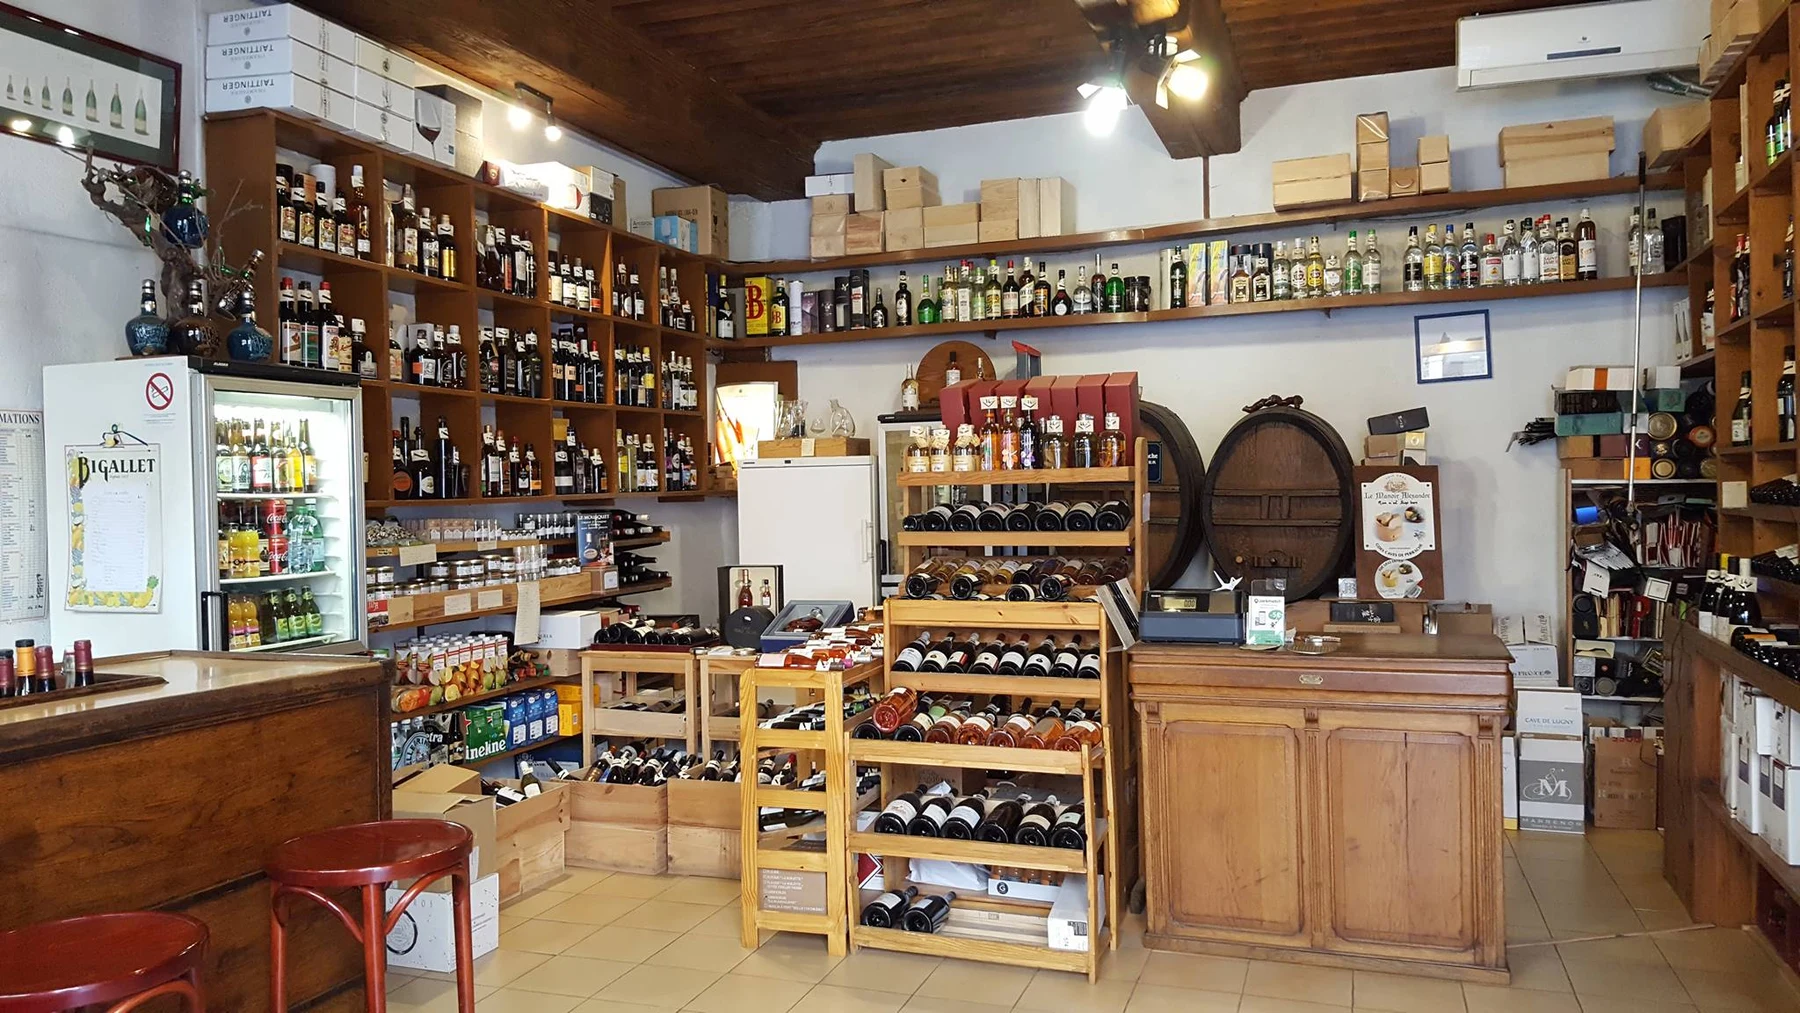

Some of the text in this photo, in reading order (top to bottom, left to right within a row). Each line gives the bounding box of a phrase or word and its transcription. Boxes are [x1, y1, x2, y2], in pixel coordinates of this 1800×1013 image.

[223, 9, 272, 23] TAITTINGER
[222, 44, 274, 57] TAITTINGER
[222, 78, 274, 91] TAITTINGER
[78, 456, 156, 489] BIGALLET
